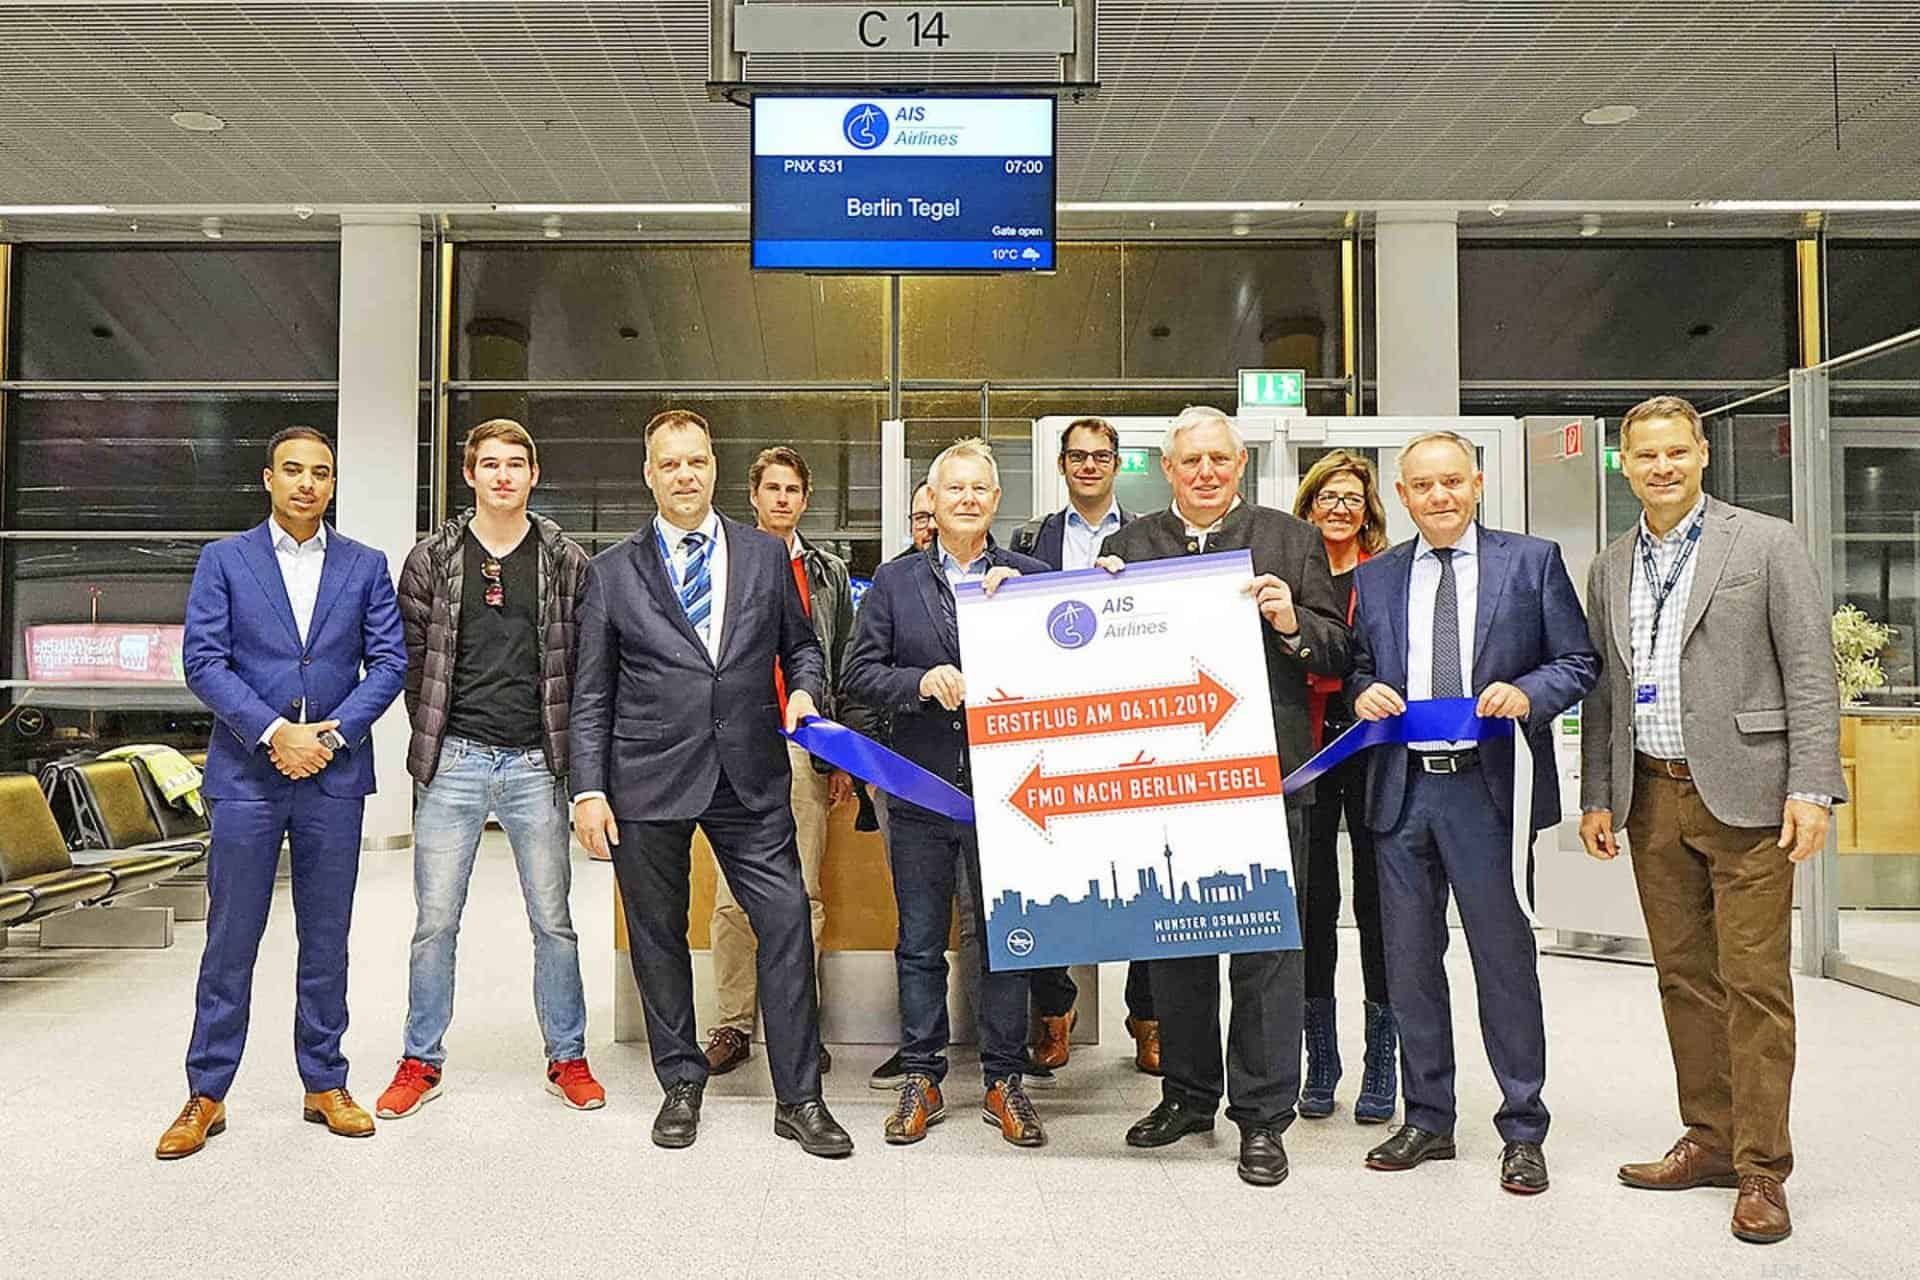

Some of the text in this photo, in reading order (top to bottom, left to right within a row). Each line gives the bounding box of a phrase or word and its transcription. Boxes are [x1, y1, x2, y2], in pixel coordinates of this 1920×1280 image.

[858, 11, 950, 47] C 14
[895, 105, 926, 122] AIS
[893, 130, 959, 146] Airlines
[783, 159, 843, 173] PNX 531
[1004, 159, 1044, 174] 07:00
[846, 197, 960, 222] Berlin Tegel
[991, 225, 1043, 238] Gate open
[1101, 595, 1135, 615] AIS
[1103, 621, 1169, 639] Airlines
[986, 692, 1219, 736] ERSTFLUG AM 04.11.2019
[1026, 766, 1267, 809] FMO NACH BERLIN-TEGEL
